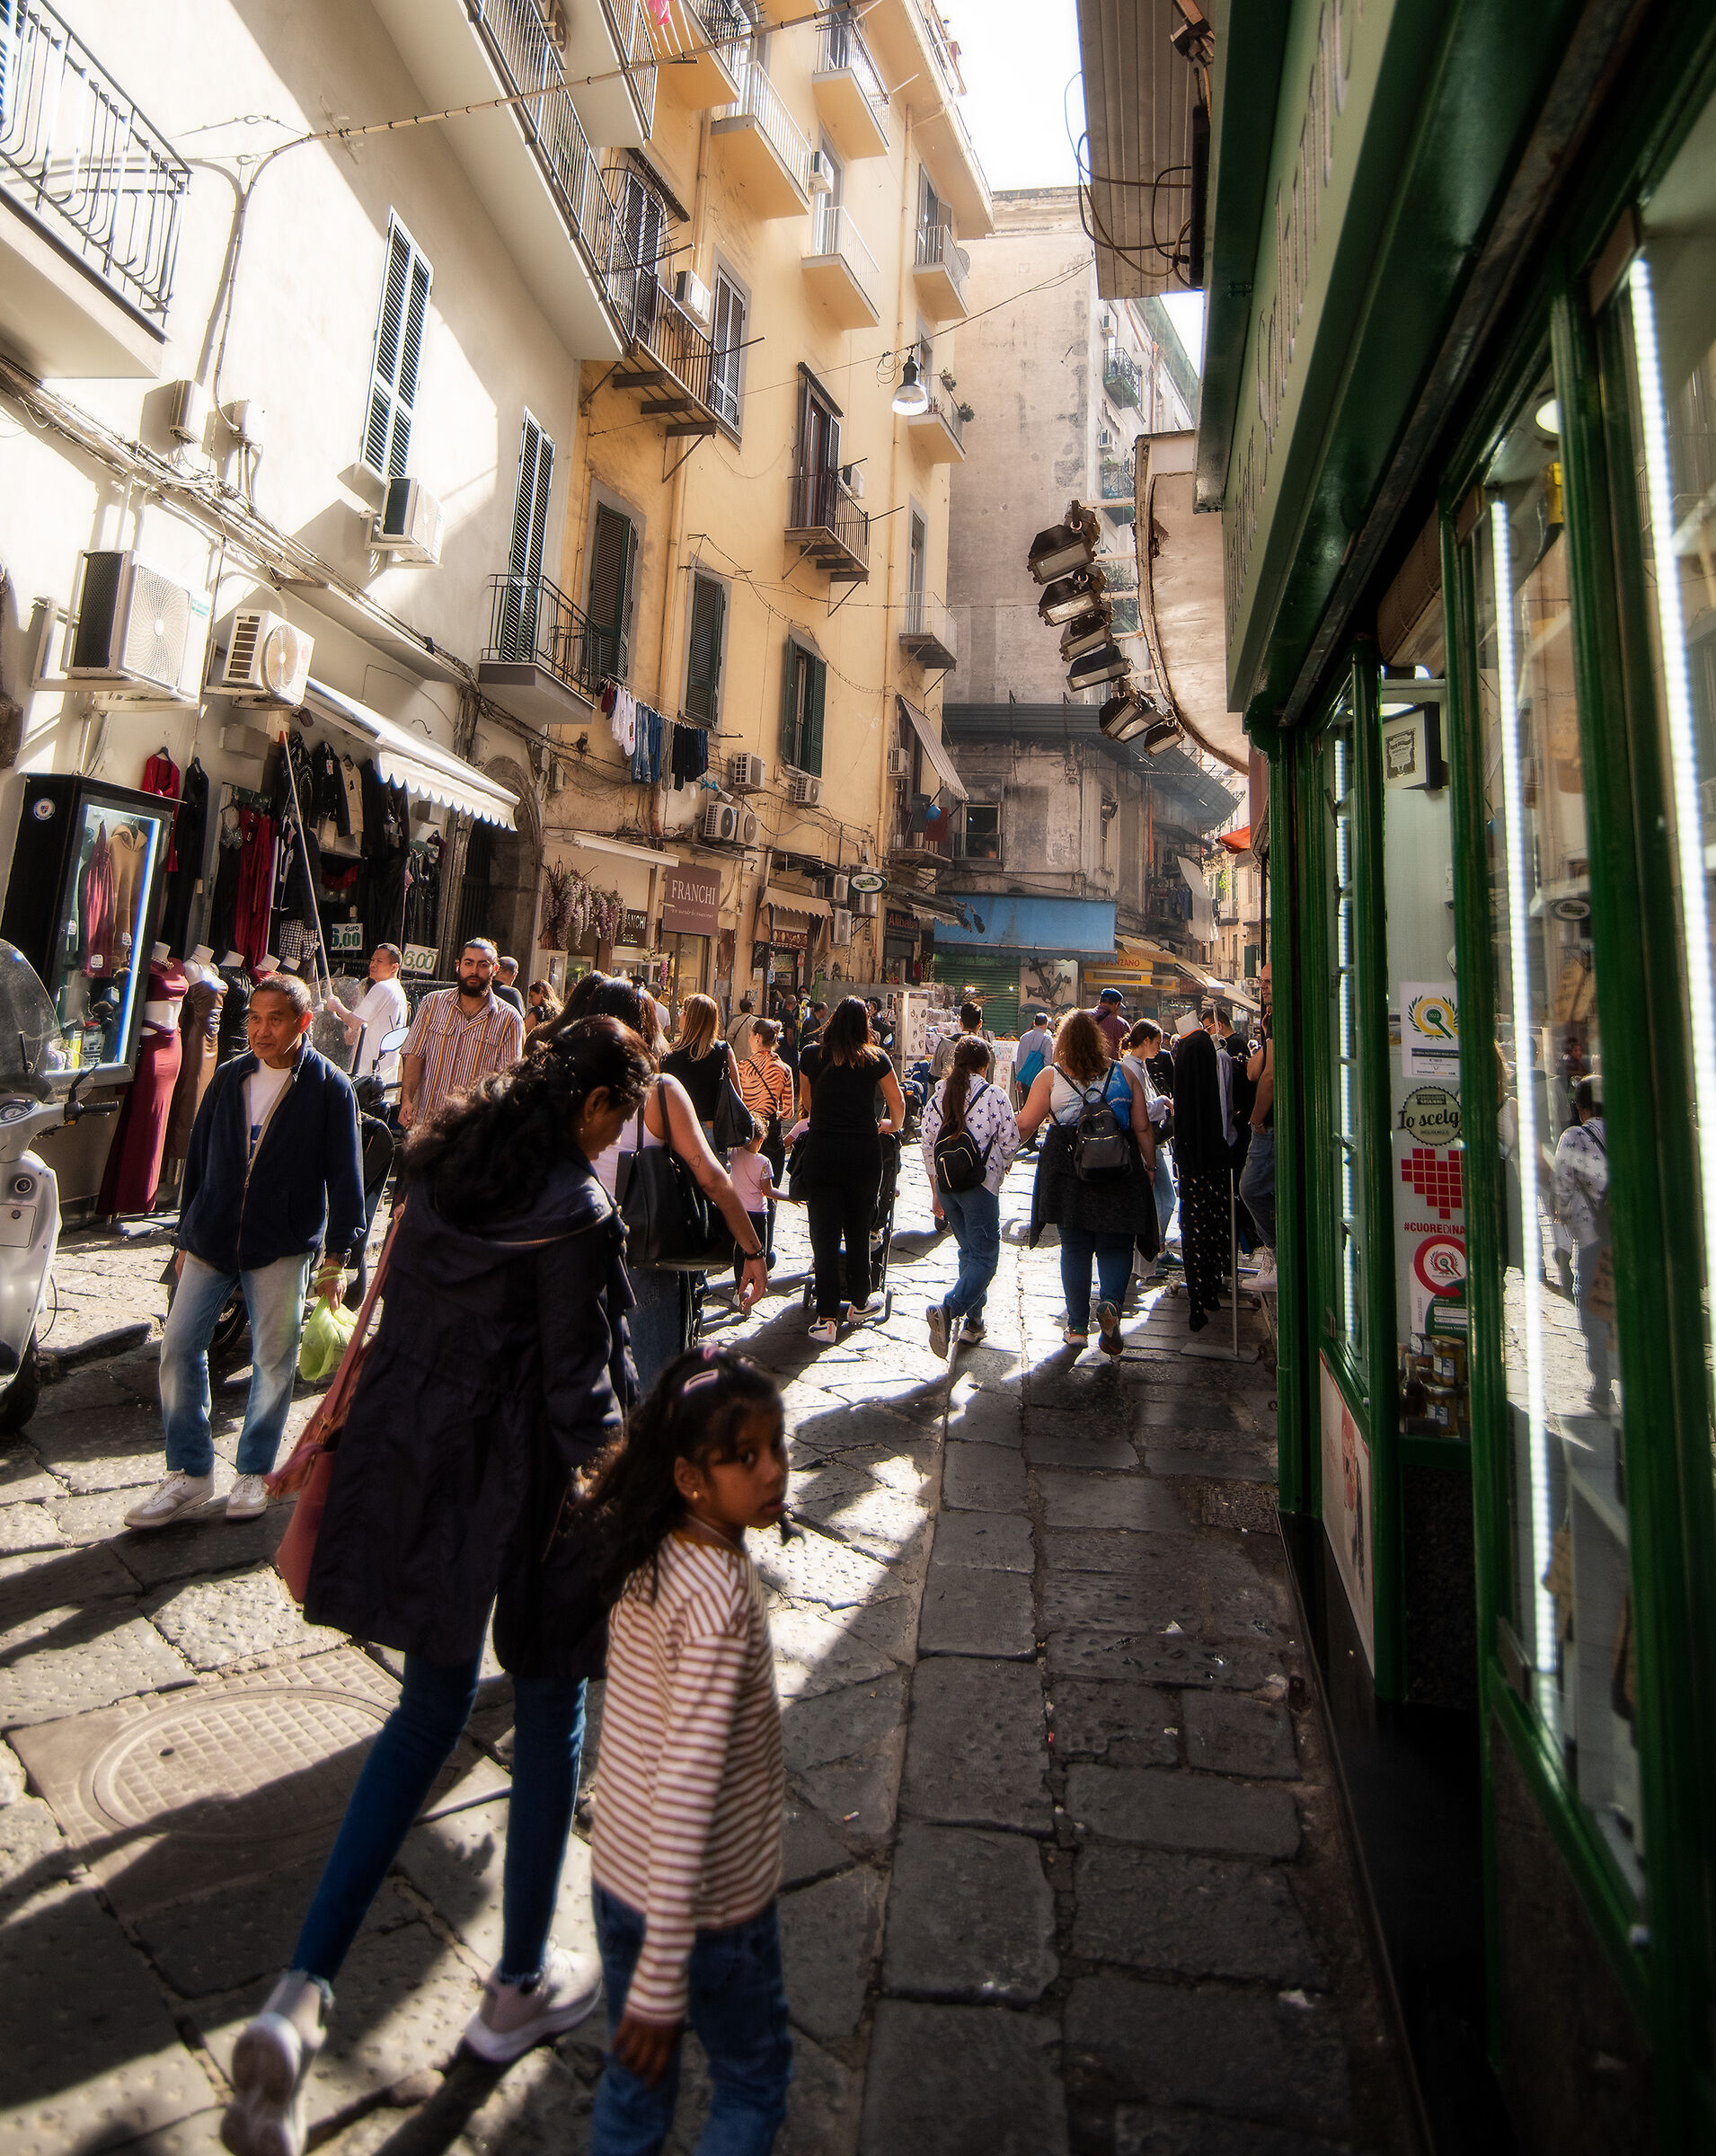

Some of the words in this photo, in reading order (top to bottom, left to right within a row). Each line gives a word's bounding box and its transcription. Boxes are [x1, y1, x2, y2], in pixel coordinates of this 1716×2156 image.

[672, 879, 715, 905] FRANCHI
[402, 950, 435, 970] 6,00
[1396, 1109, 1415, 1130] Io
[1419, 1109, 1461, 1128] scelg
[1403, 1223, 1465, 1234] #CUOREDINA
